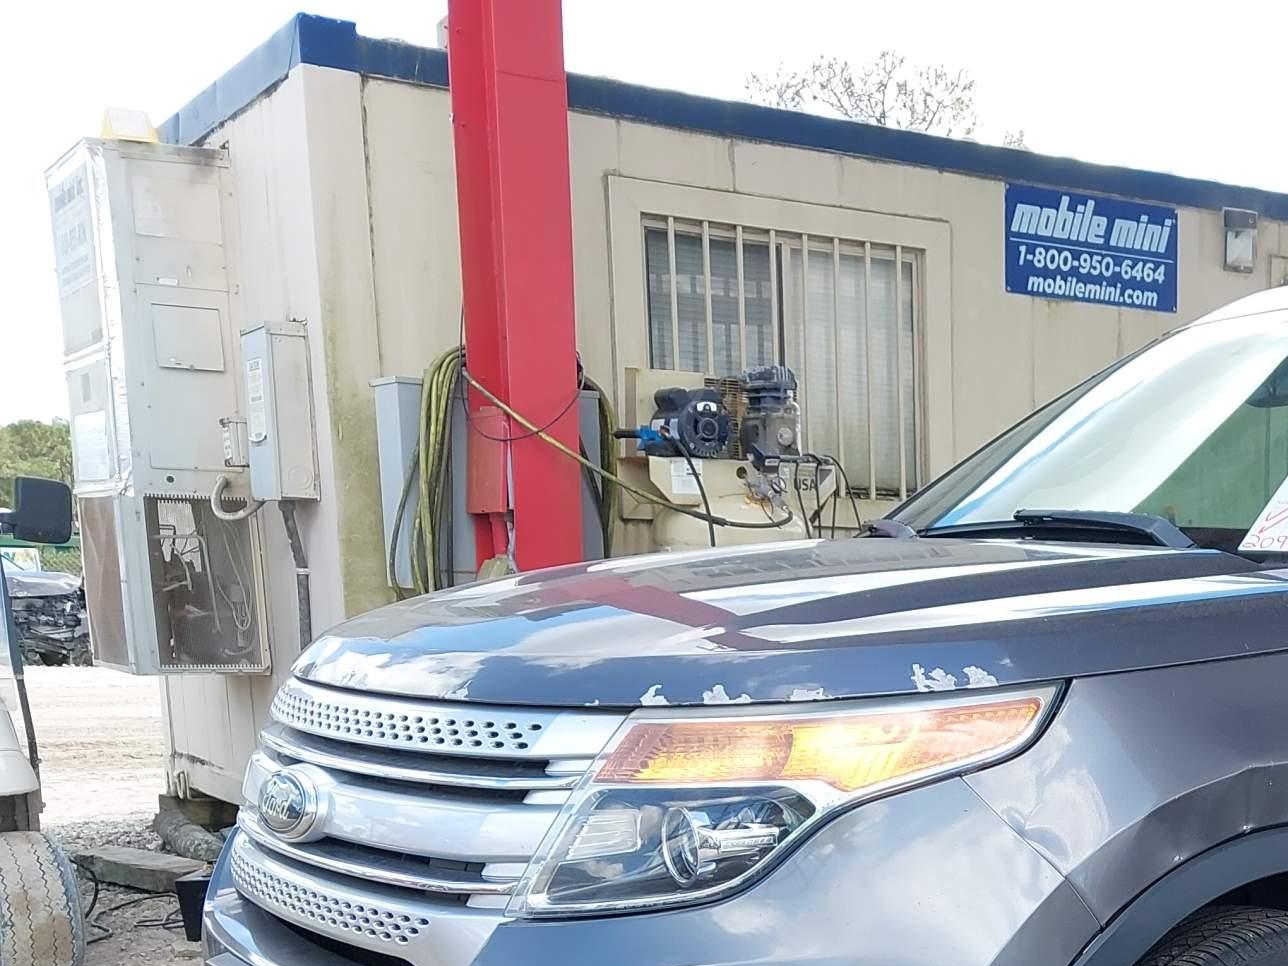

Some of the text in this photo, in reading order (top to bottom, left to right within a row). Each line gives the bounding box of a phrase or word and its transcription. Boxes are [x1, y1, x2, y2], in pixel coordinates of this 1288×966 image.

[1010, 195, 1173, 253] mobile mini
[1018, 244, 1166, 284] 1-800-950-6464
[1027, 275, 1158, 307] mobilemini.com
